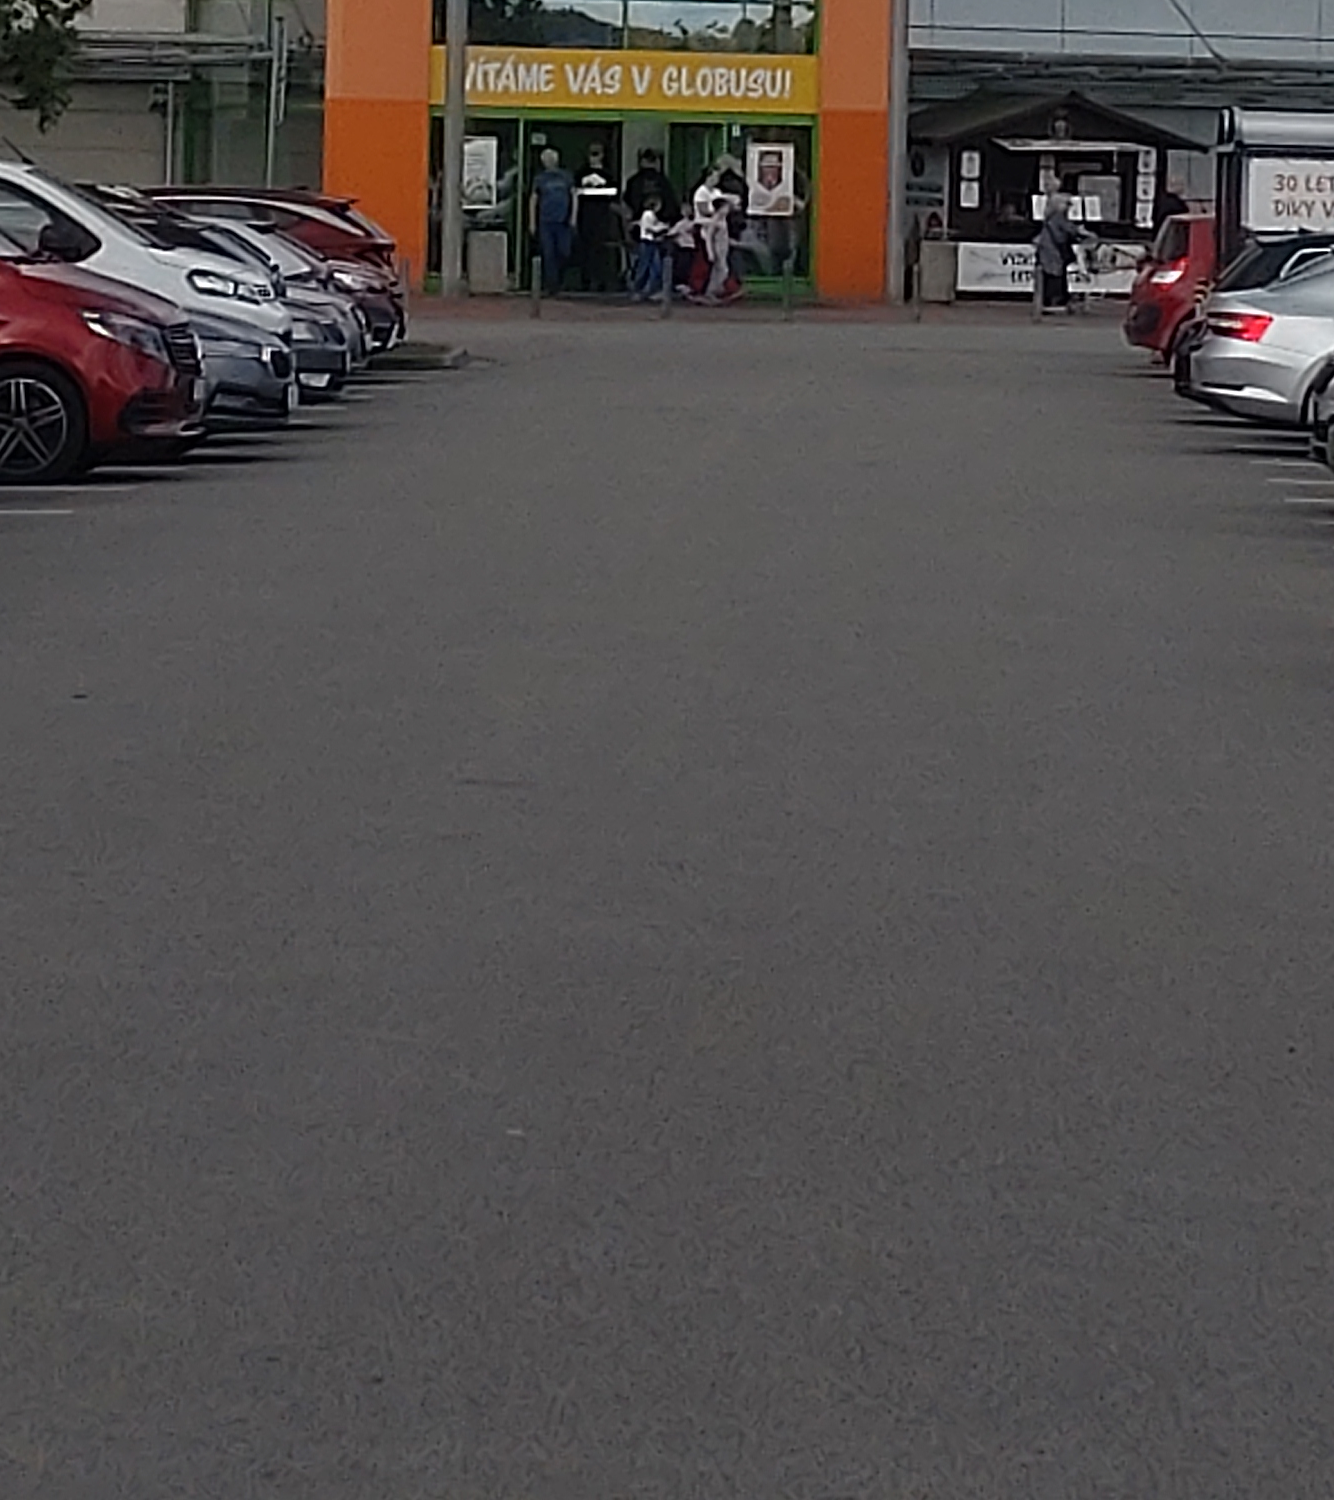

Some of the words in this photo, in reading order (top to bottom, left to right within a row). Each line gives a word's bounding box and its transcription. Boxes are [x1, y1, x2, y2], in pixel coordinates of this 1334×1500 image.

[565, 58, 622, 95] VÁS
[630, 65, 652, 95] V
[661, 67, 792, 99] GLOBUSU!
[1274, 174, 1298, 192] 30
